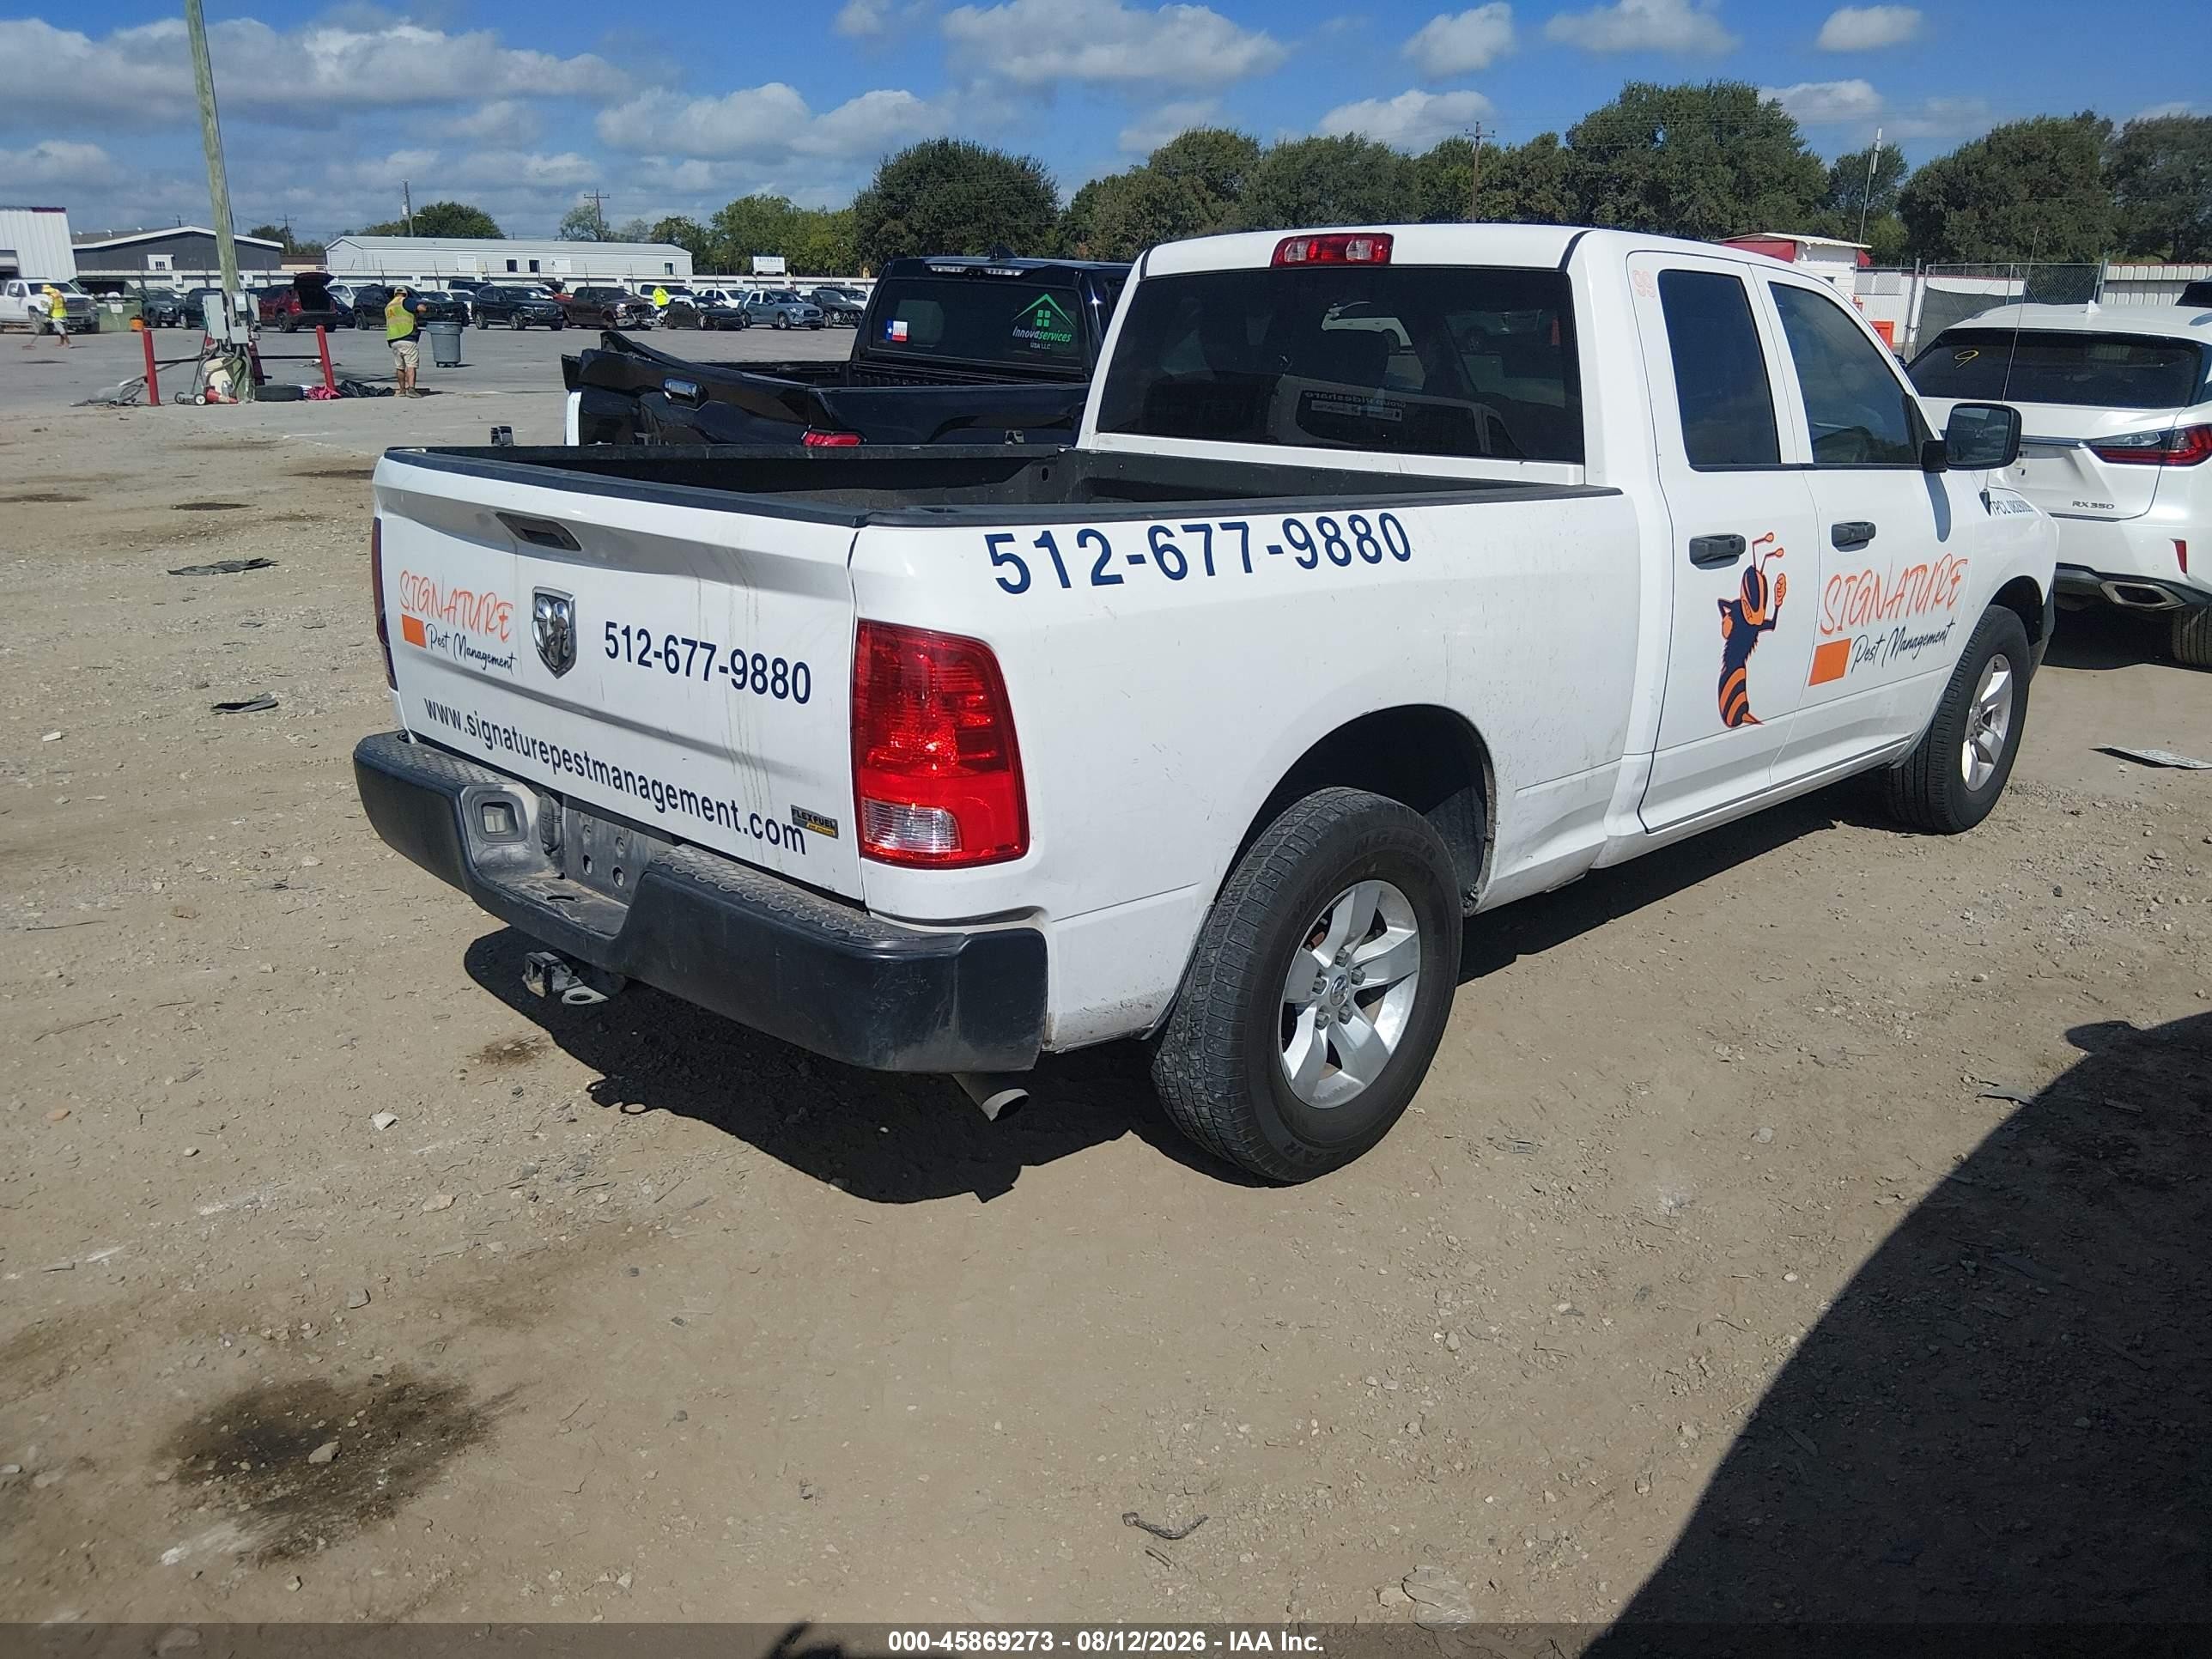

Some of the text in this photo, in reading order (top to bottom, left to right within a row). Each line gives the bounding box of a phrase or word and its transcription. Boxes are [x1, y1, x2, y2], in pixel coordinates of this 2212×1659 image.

[984, 513, 1411, 594] 512-677-9880
[1820, 553, 1968, 635] SIGNATURE
[399, 570, 514, 643] SIGNATURE
[1850, 618, 1956, 673] Pest Management
[426, 623, 517, 677] Pest Management
[605, 621, 811, 705] 512-677-9880
[423, 696, 806, 856] www.signaturepestmanagement.com
